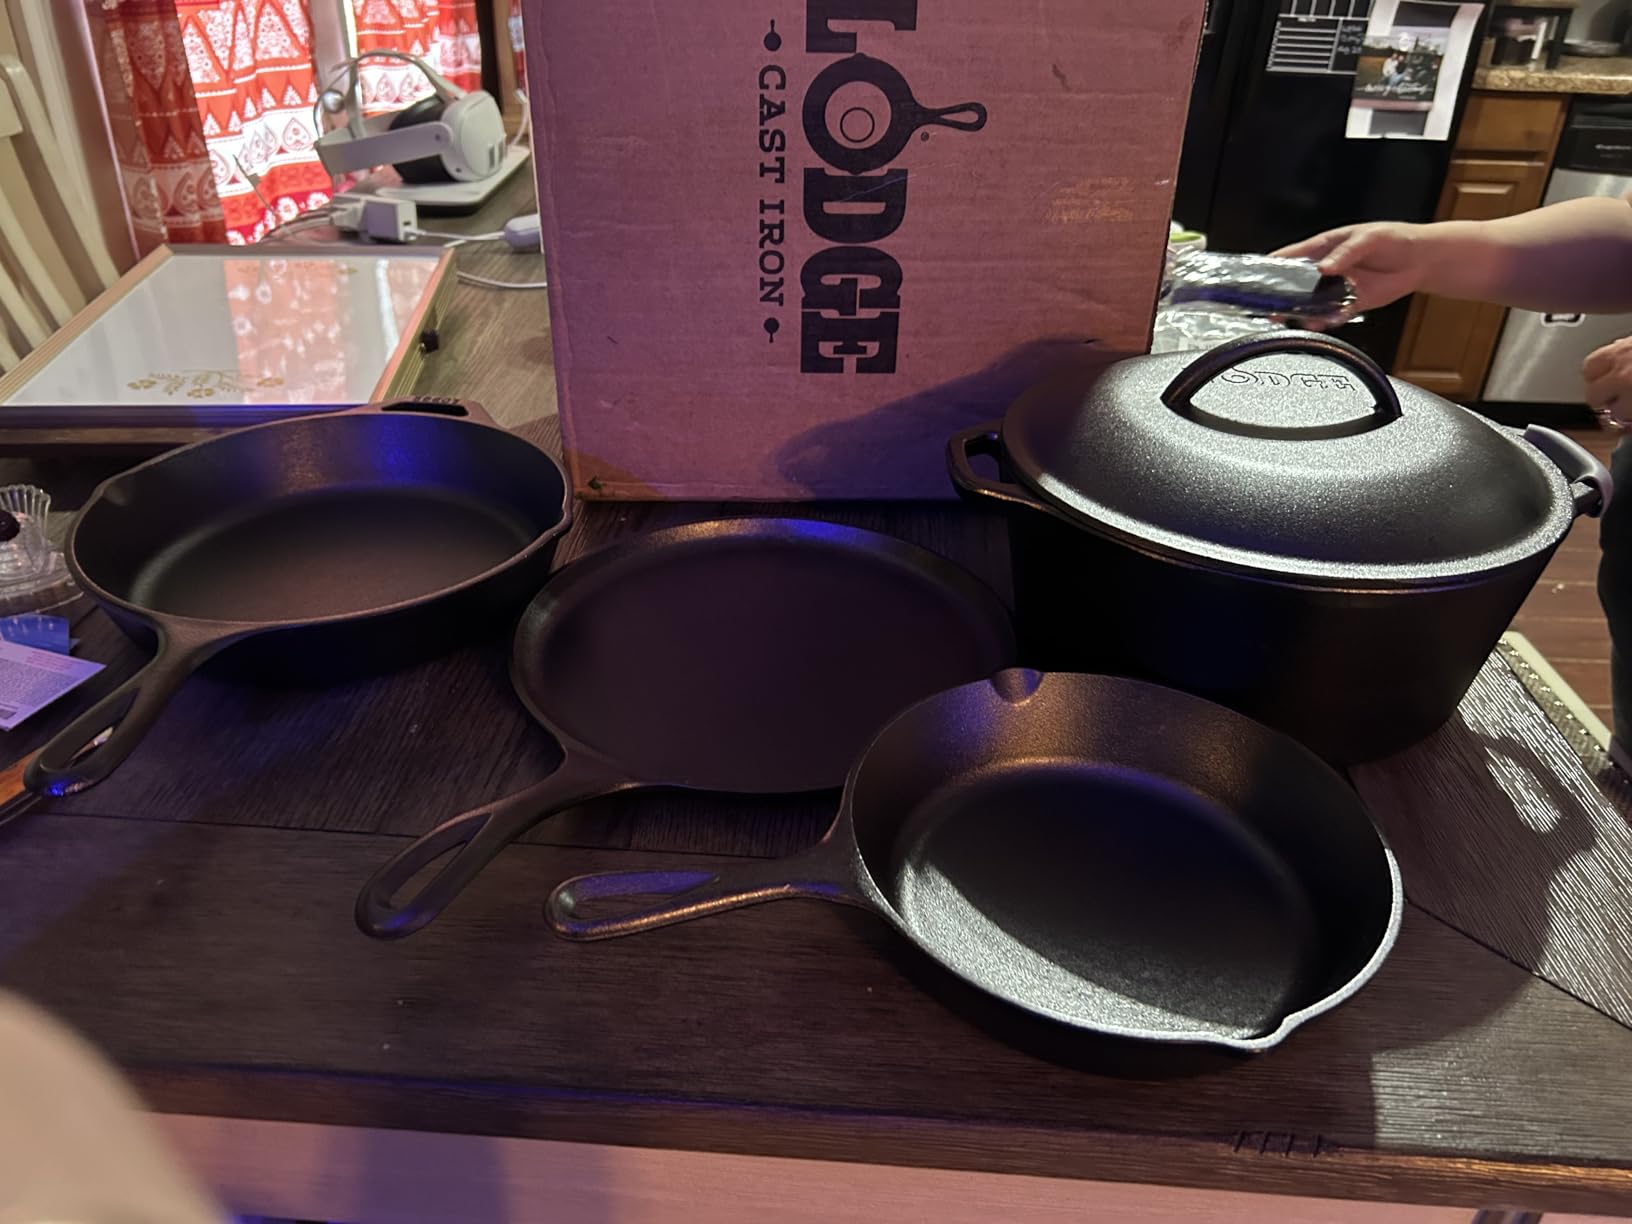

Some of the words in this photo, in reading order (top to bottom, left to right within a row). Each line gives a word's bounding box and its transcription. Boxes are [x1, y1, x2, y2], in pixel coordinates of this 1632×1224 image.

[758, 65, 787, 184] CAST
[800, 0, 917, 373] LODGE
[758, 199, 785, 306] IRON
[1211, 366, 1358, 392] ODGE
